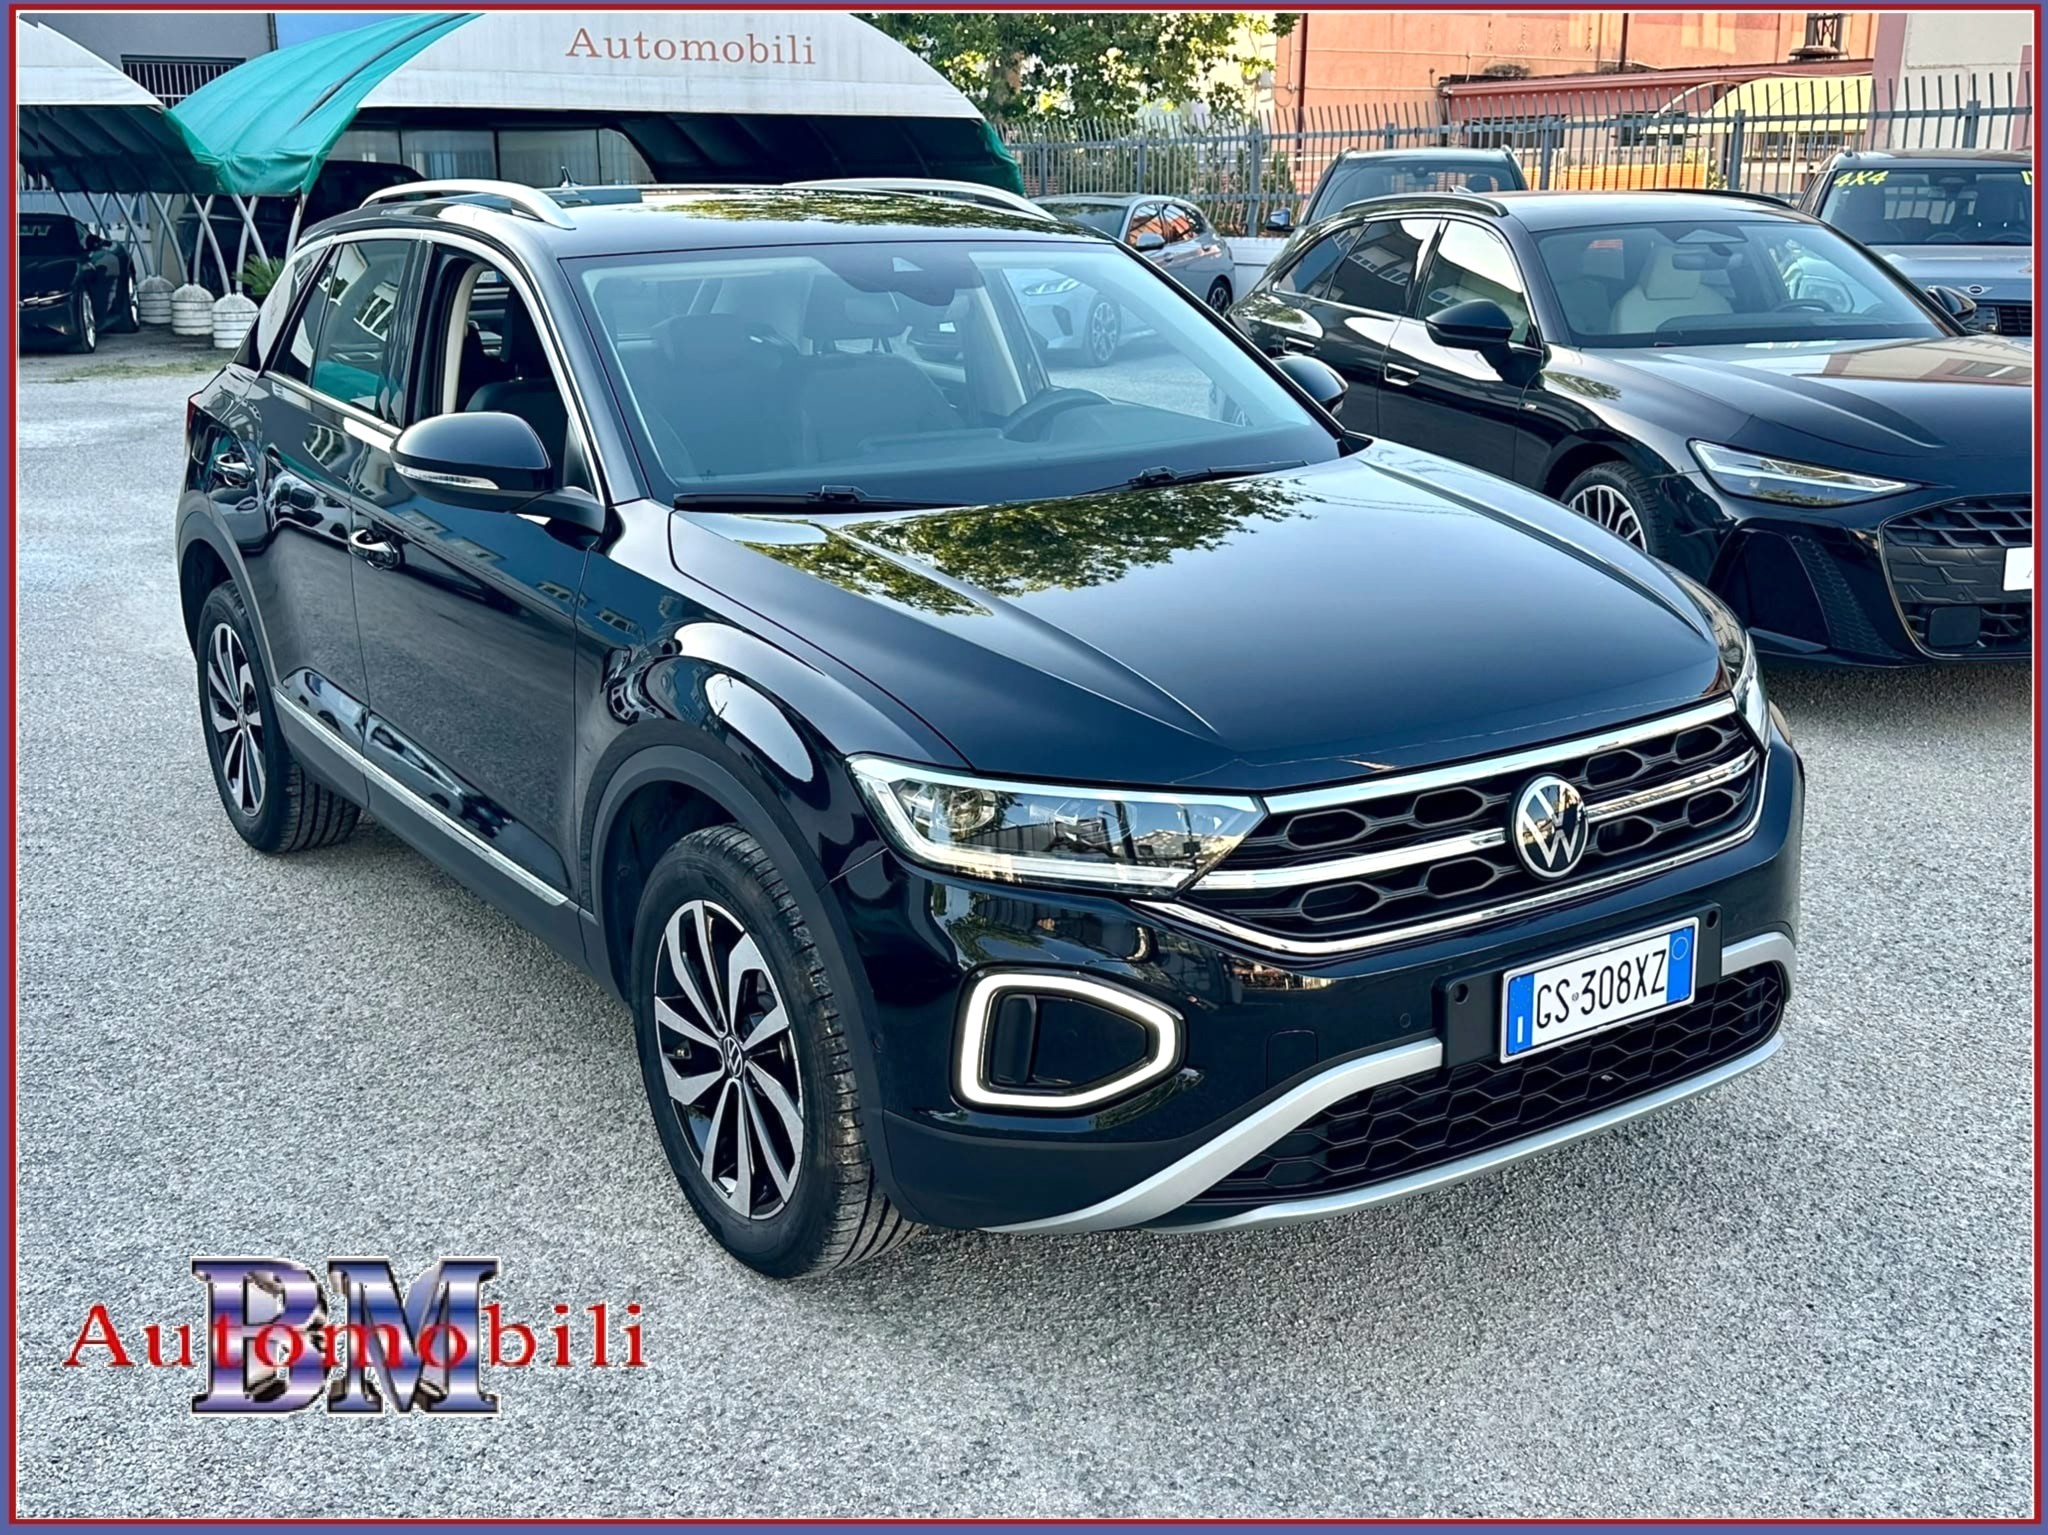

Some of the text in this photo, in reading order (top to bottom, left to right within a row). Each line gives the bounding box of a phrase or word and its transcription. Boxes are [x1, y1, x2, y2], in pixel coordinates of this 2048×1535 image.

[565, 27, 816, 65] Automobili
[1536, 948, 1667, 1029] GS 308XZ
